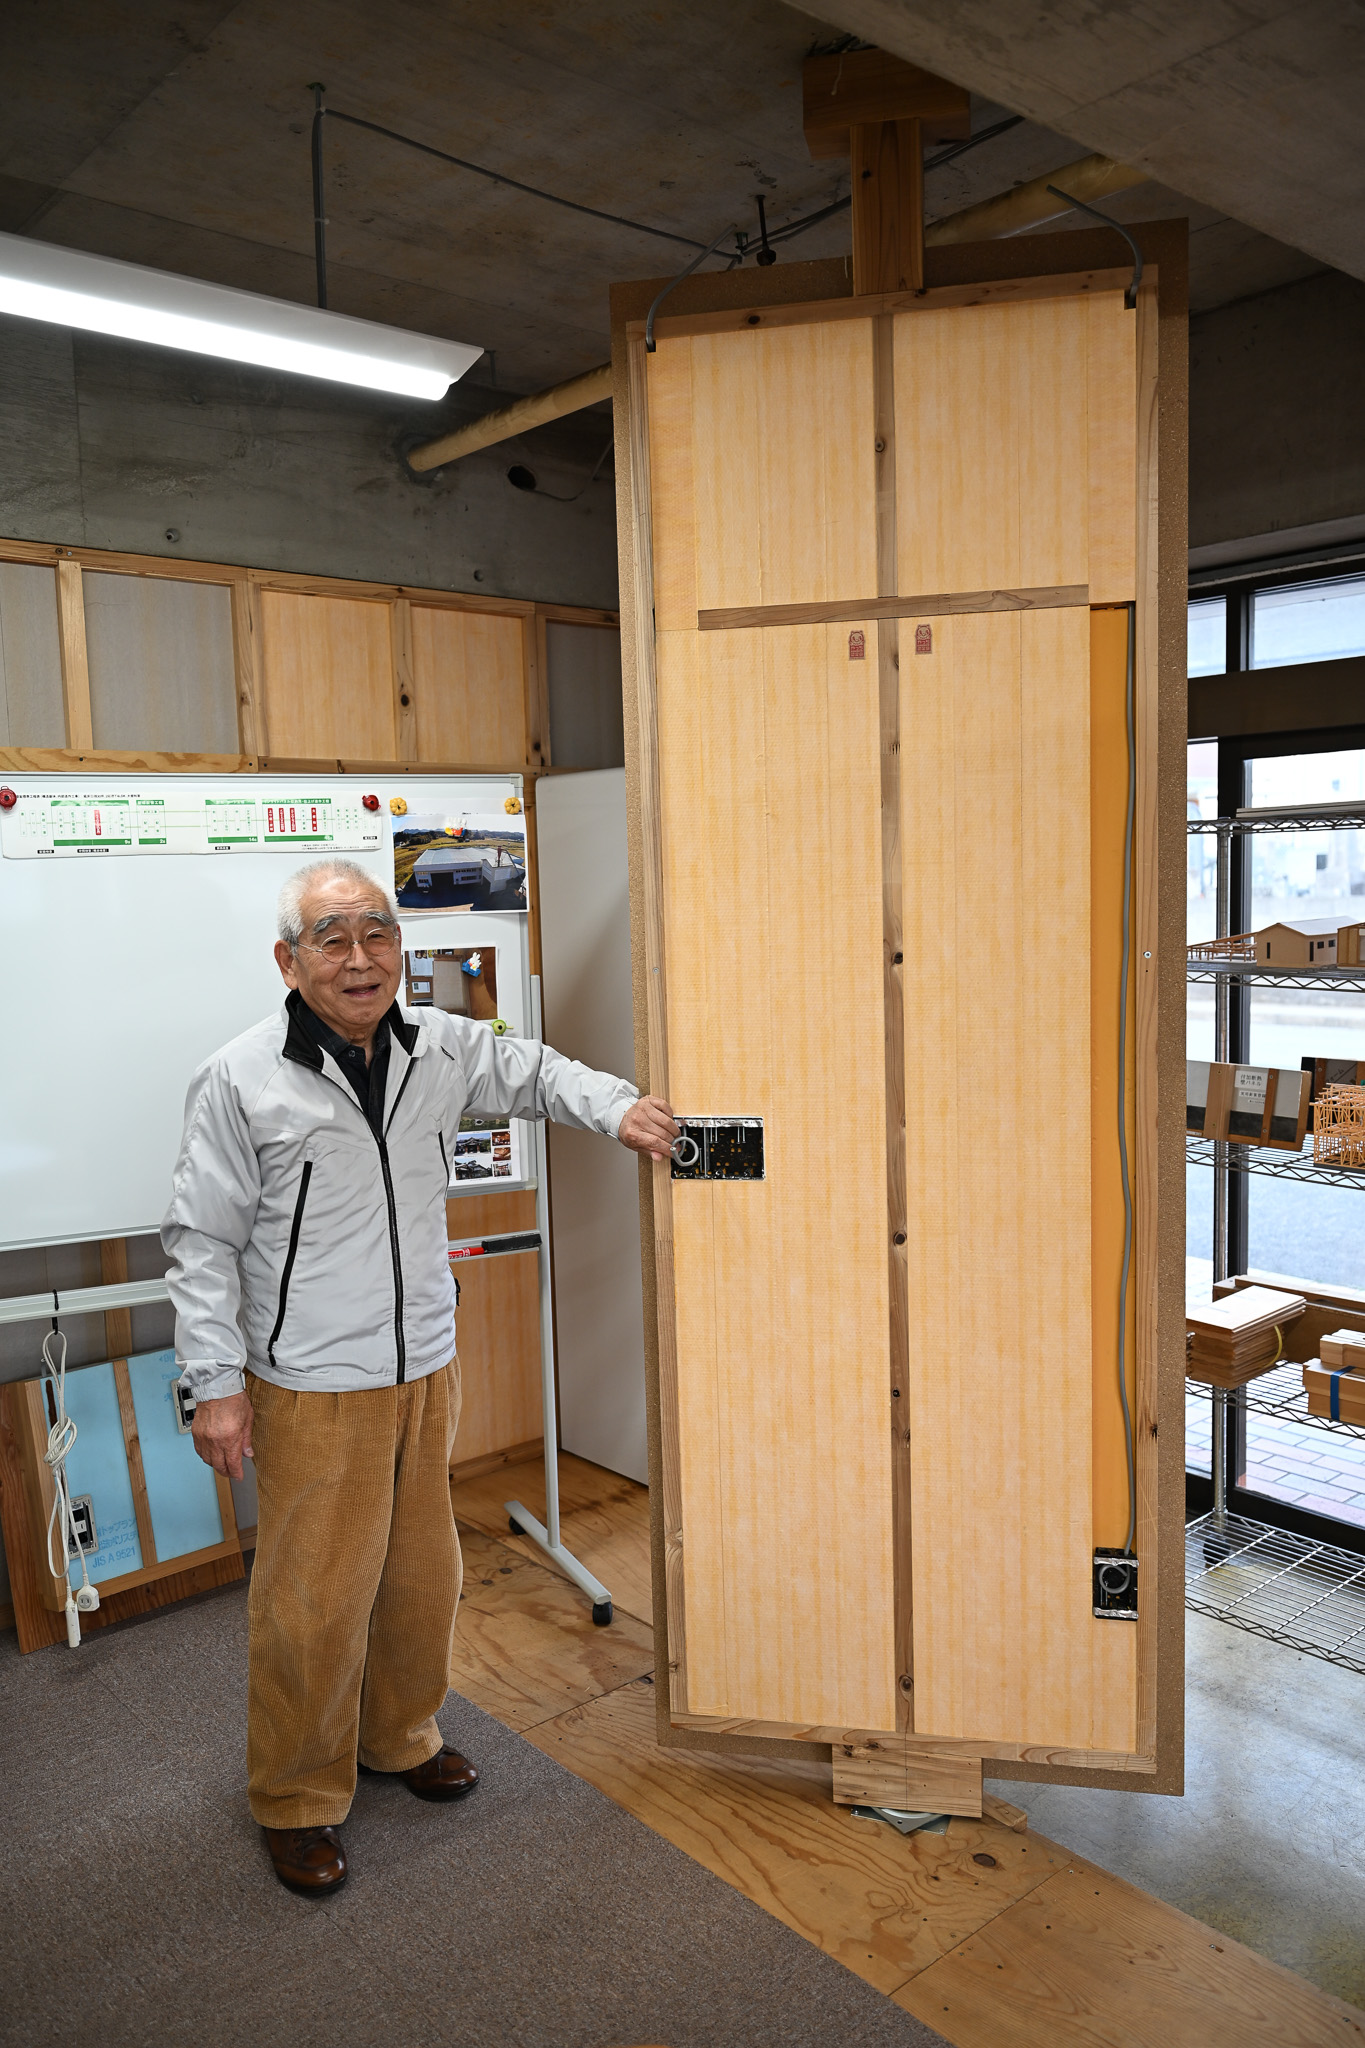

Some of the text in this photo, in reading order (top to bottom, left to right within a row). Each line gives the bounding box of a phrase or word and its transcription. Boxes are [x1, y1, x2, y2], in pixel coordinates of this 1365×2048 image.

[92, 1546, 136, 1569] JIS A 9521
